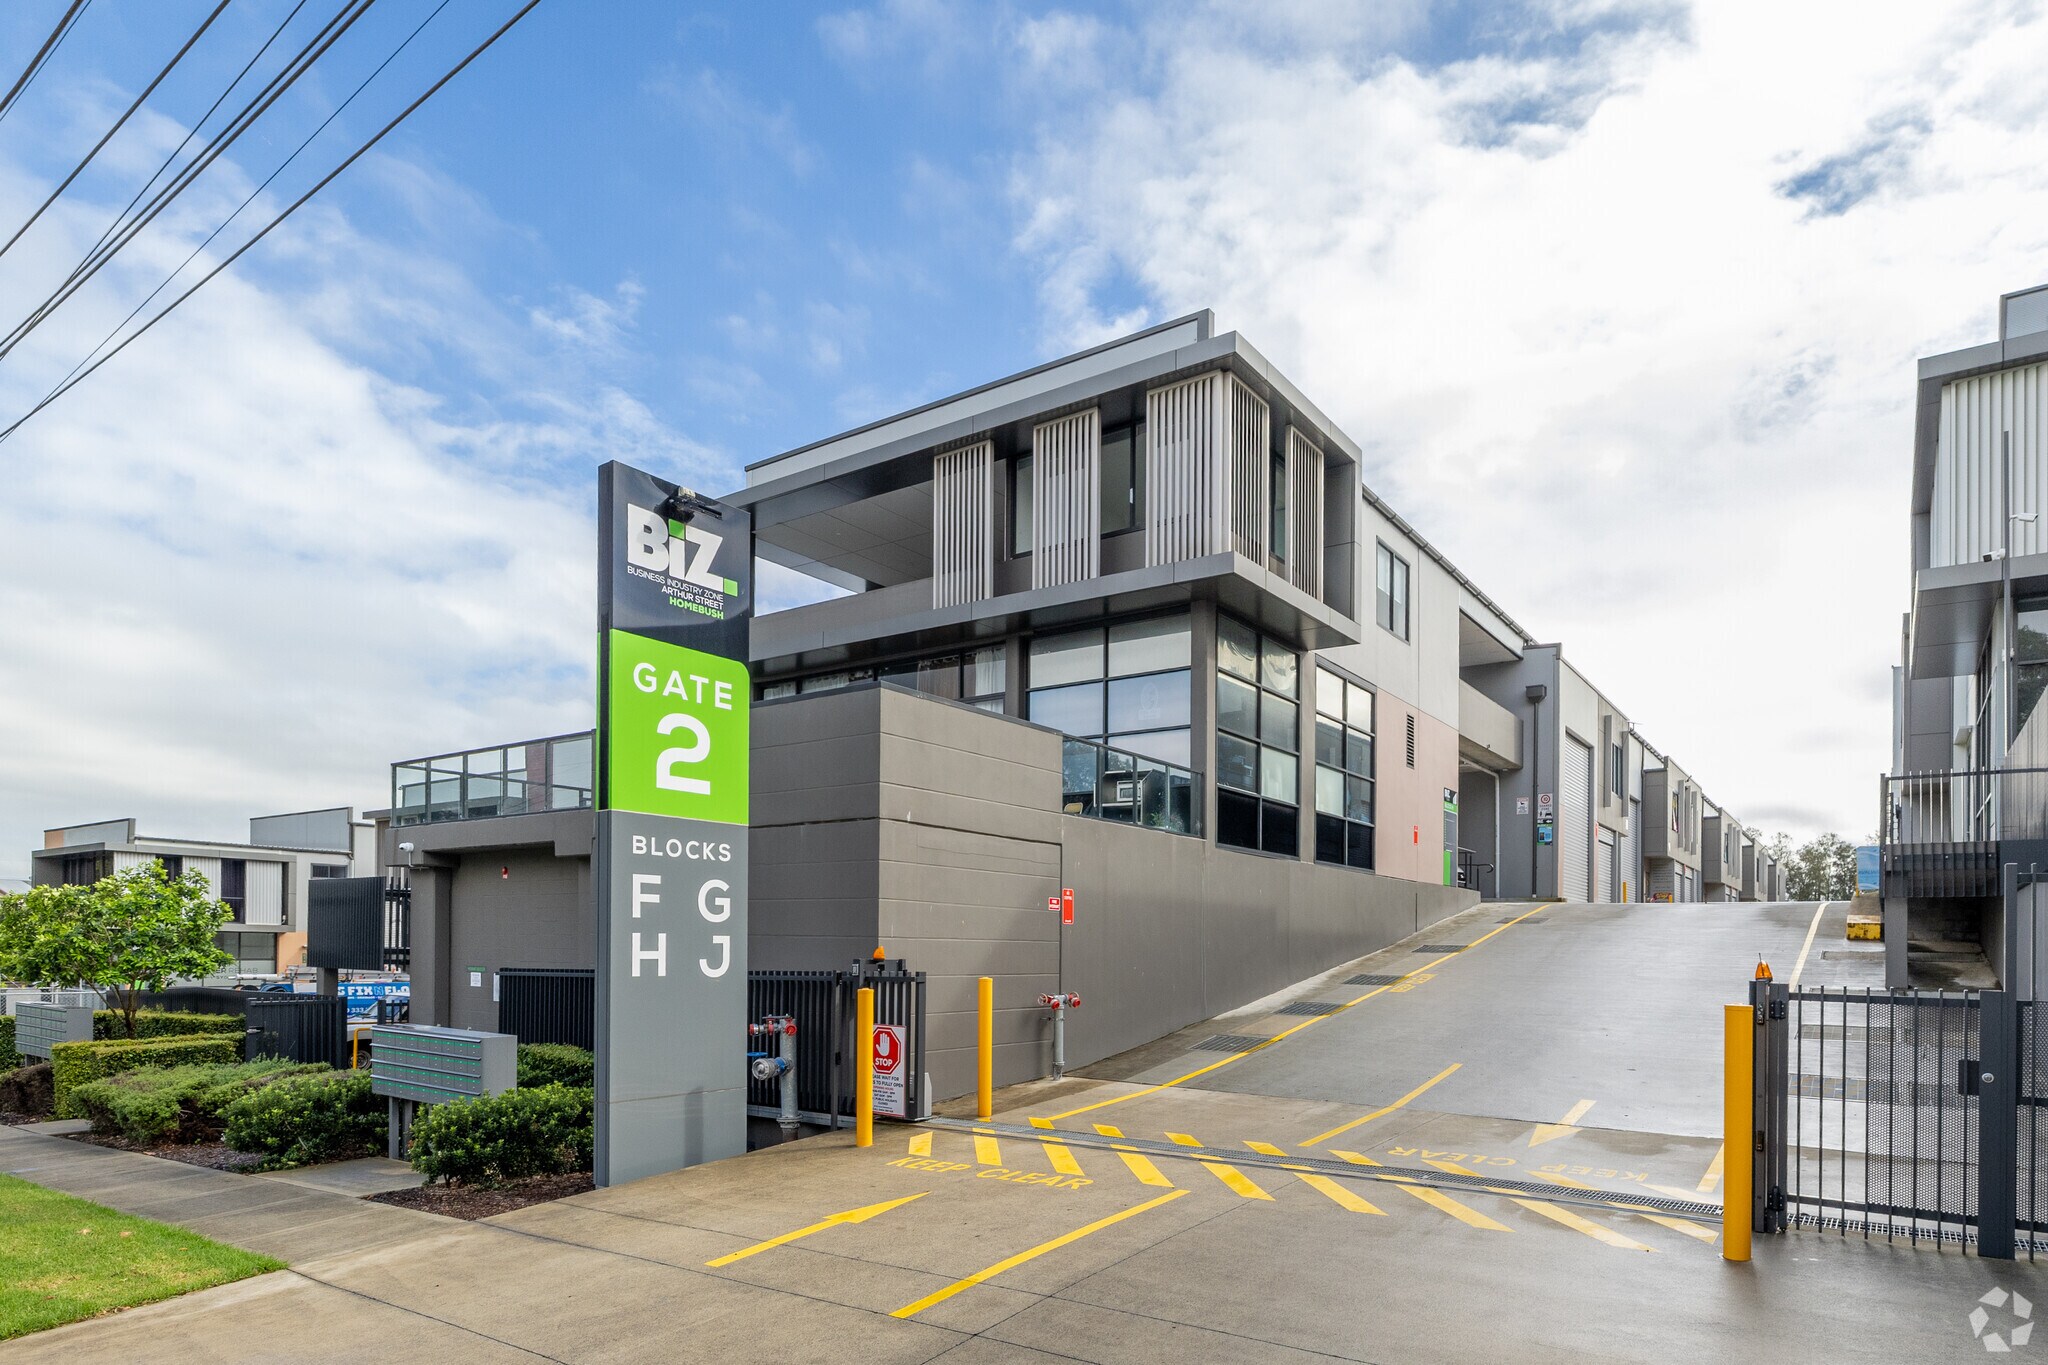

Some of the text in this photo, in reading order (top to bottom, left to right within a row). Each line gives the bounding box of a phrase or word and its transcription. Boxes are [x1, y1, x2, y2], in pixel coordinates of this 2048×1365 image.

[628, 565, 724, 600] BUSINESS INDUSTRY ZONE
[661, 585, 723, 610] ARTHUR STREET
[669, 596, 724, 620] HOMEBUSH
[633, 662, 732, 710] GATE
[656, 713, 711, 795] 2
[632, 835, 731, 862] BLOCKS
[632, 874, 731, 923] F G
[632, 933, 731, 978] H J
[875, 1058, 892, 1066] STOP
[886, 1157, 1094, 1190] KEEP CLEAR
[1387, 1146, 1649, 1182] KEEP CLEAR
